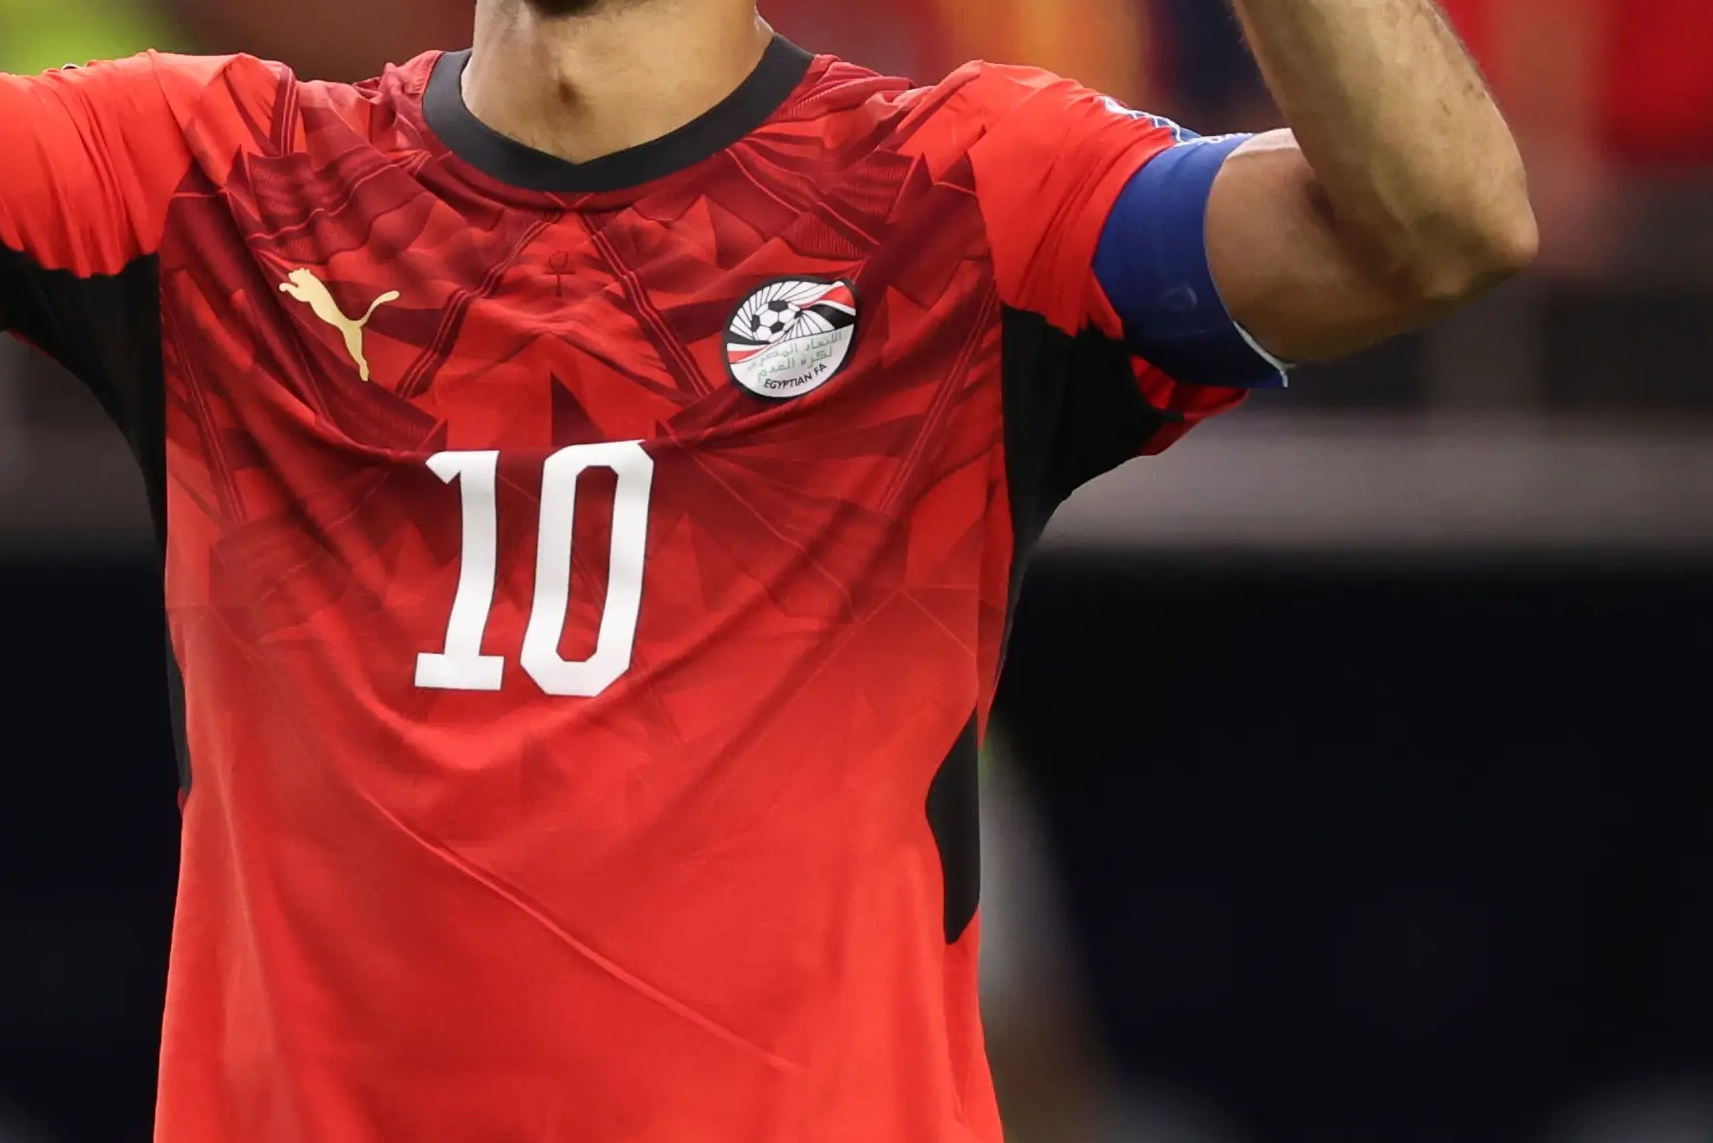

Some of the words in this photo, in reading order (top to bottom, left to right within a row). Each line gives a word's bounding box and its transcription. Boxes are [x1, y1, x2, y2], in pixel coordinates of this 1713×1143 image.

[763, 373, 812, 390] EGYPTIAN
[813, 363, 827, 376] FA
[415, 439, 654, 697] 10
